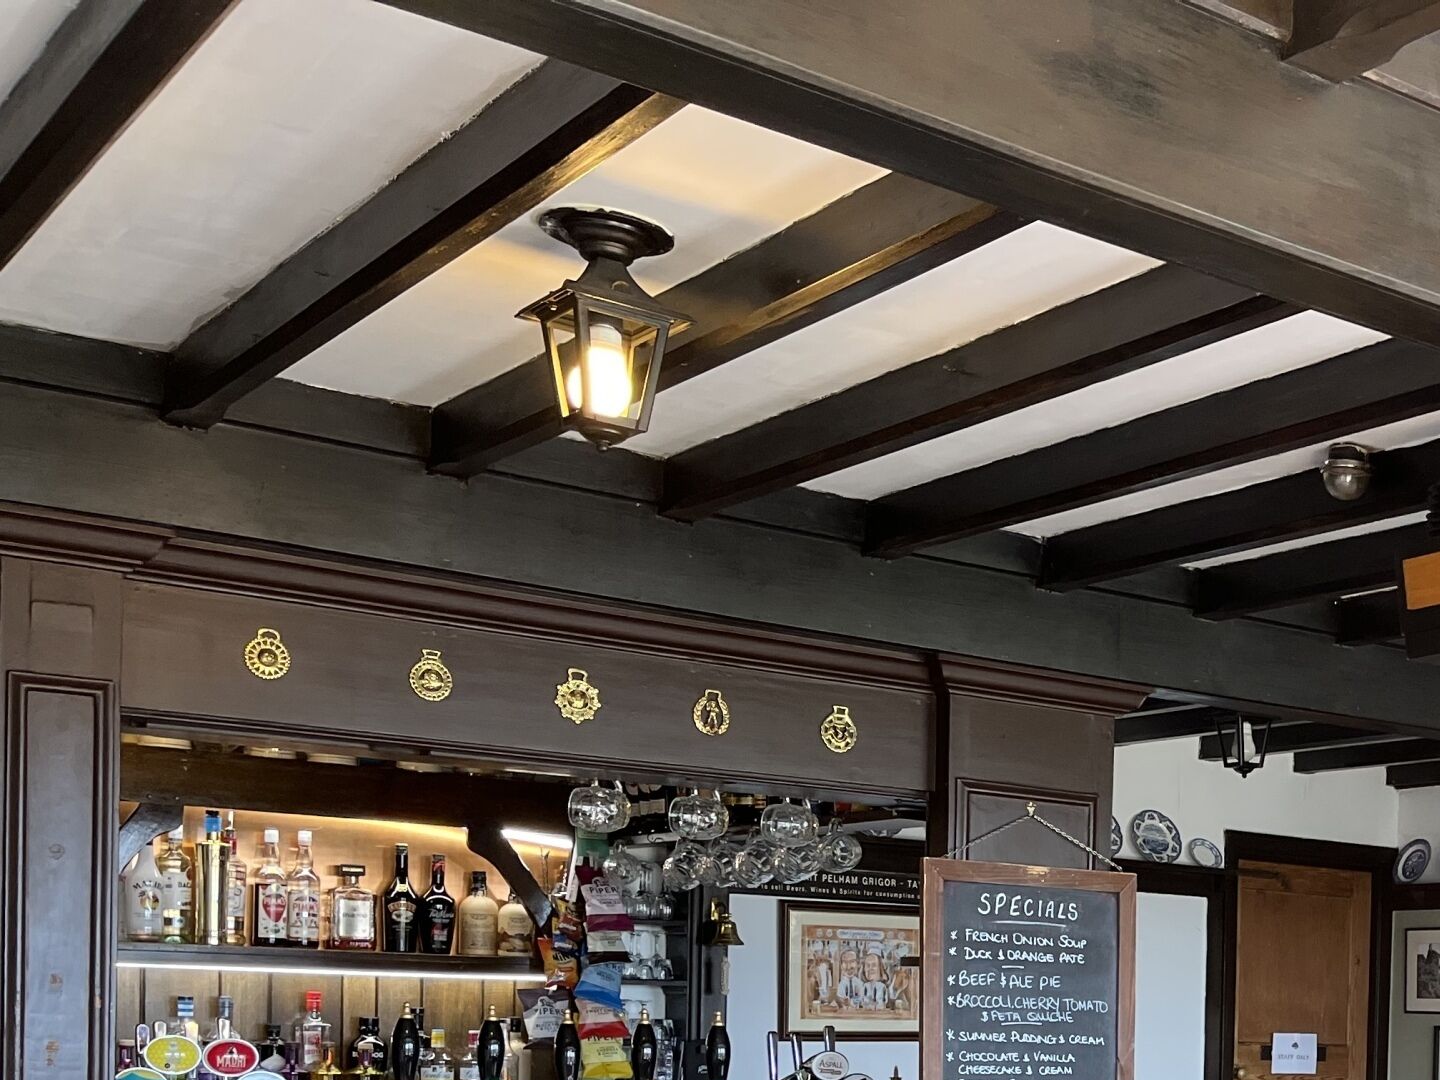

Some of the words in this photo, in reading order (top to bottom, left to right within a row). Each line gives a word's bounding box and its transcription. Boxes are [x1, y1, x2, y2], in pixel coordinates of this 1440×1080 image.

[822, 873, 858, 885] PELHAM
[862, 876, 897, 887] GRIGOR
[875, 891, 915, 899] consumption
[978, 893, 1078, 921] SPECIALS
[965, 929, 1008, 943] FRENCH
[1013, 933, 1054, 947] ONION
[1058, 935, 1087, 949] SOUP
[964, 947, 992, 960] DUCK
[1007, 950, 1054, 963] ORANGE
[1059, 953, 1085, 964] PATE
[959, 970, 996, 986] BEEF
[1009, 976, 1034, 989] ALE
[1039, 976, 1061, 990] PIE
[1014, 996, 1060, 1012] CHERRY
[1063, 998, 1109, 1013] TOMATO
[991, 1011, 1022, 1022] FETA
[958, 1032, 1007, 1042] SUMMER
[1010, 1031, 1056, 1044] PUDDING
[1069, 1034, 1105, 1046] CREAM
[820, 1059, 843, 1069] ASPALL
[958, 1051, 1020, 1062] CHOCOLATE
[1034, 1051, 1076, 1063] VANILLA
[958, 1065, 1022, 1075] CHEESECAKE
[1039, 1066, 1073, 1075] CREAM
